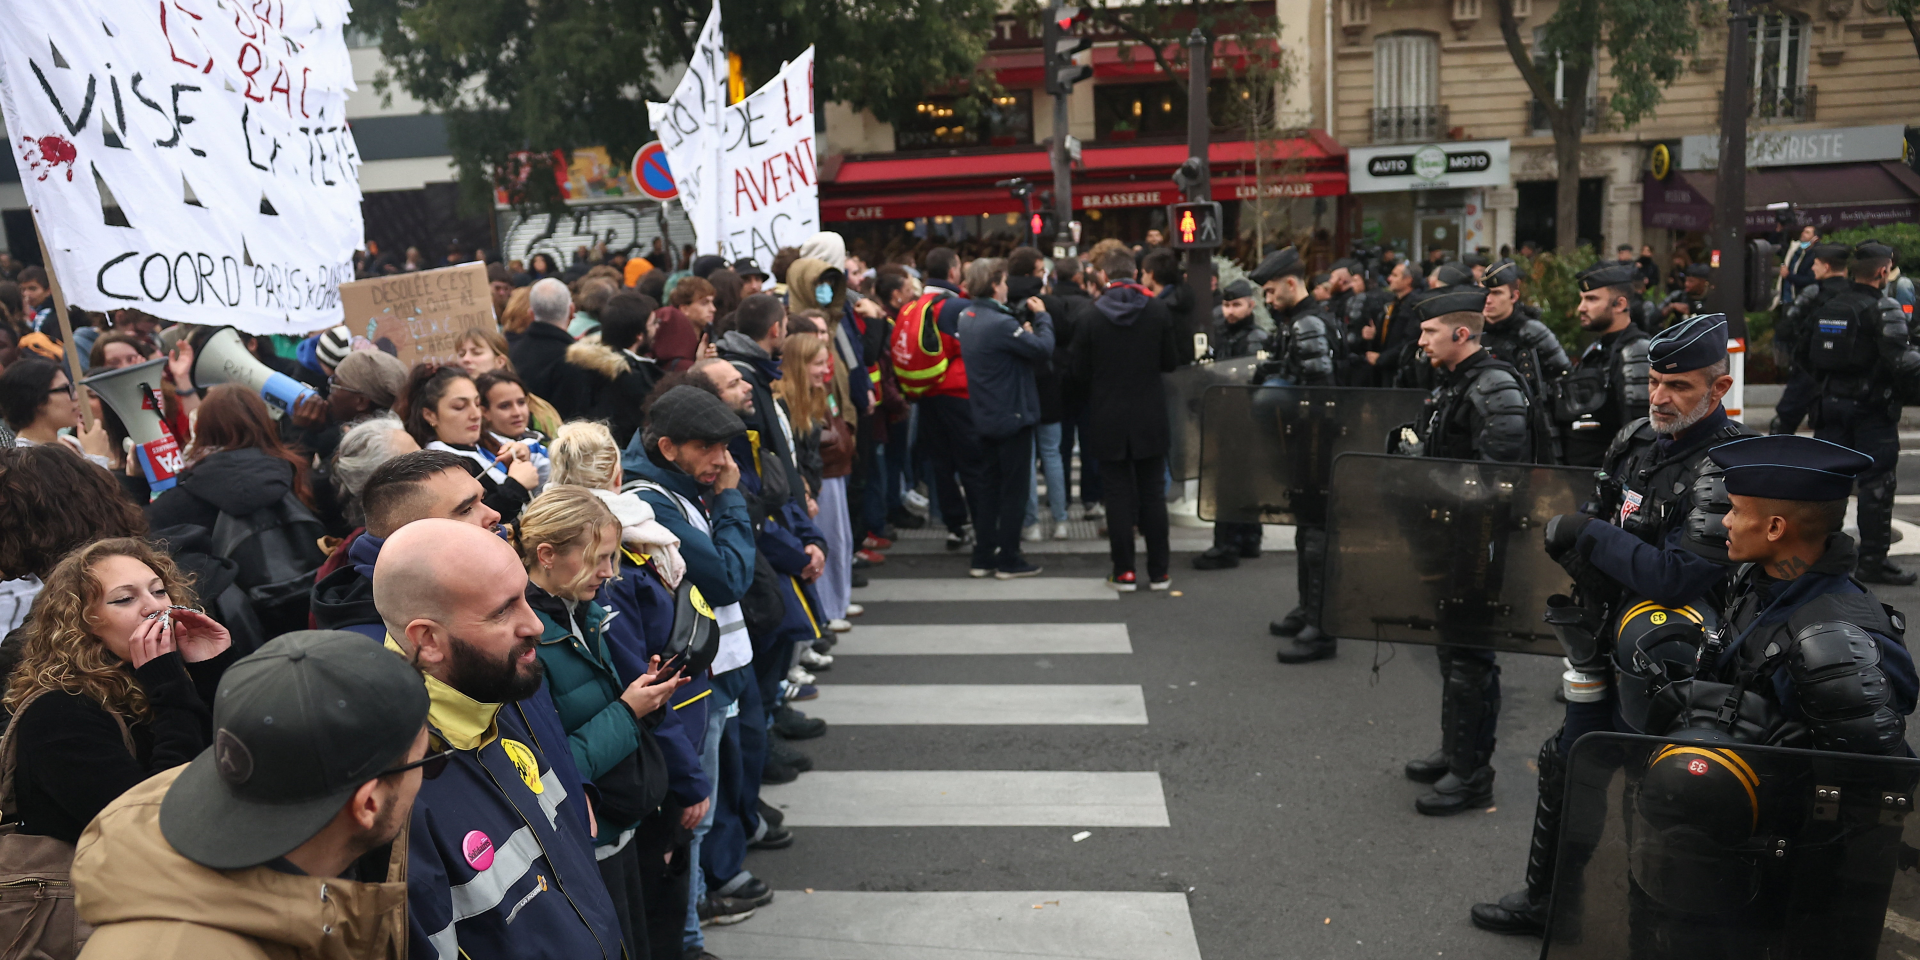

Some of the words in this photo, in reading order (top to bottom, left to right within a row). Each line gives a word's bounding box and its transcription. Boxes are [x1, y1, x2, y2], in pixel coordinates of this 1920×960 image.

[1752, 132, 1844, 162] LEURISTE
[1372, 159, 1408, 173] AUTO
[1450, 155, 1488, 168] MOTO
[1082, 191, 1161, 208] BRASSERIE
[845, 206, 885, 219] CAFE
[97, 251, 241, 307] COORD
[1652, 613, 1664, 622] 33
[1690, 760, 1707, 773] 33
[467, 839, 491, 861] Solidaires
